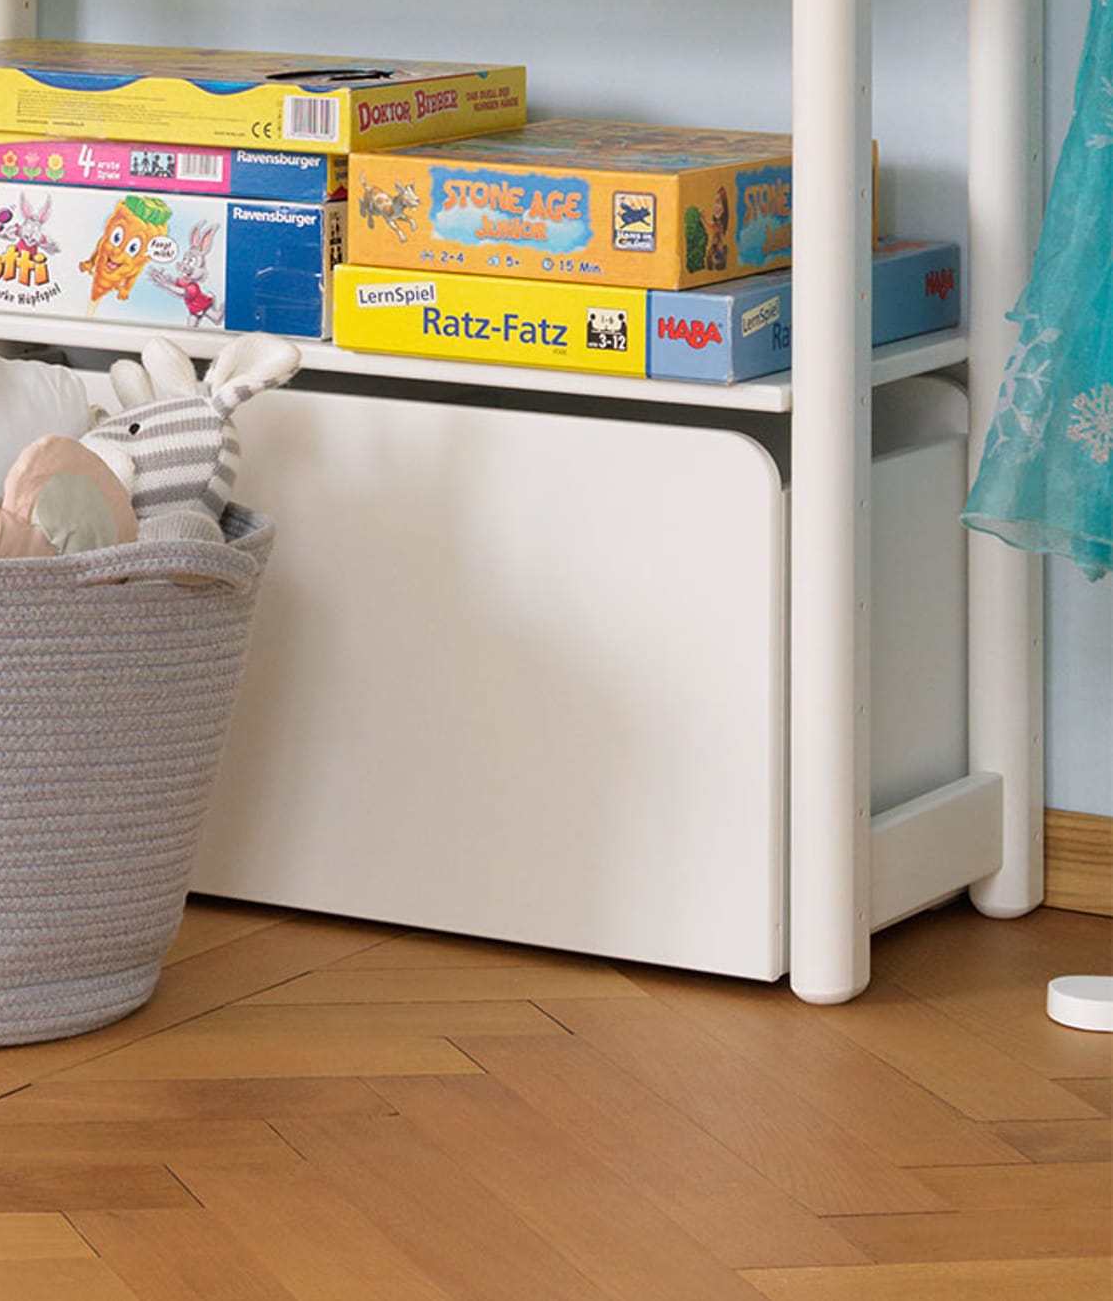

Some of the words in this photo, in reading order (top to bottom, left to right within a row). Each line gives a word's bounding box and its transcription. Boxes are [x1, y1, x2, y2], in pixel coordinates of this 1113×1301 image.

[358, 101, 412, 132] DOKTOR
[415, 90, 458, 119] BIBBER
[77, 144, 96, 179] 4
[237, 151, 322, 169] Ravensburger
[442, 180, 525, 214] STONE
[529, 191, 582, 222] AGE
[233, 207, 317, 227] Ravensburger
[475, 216, 548, 241] JUNIOR
[559, 260, 574, 272] 15
[359, 285, 435, 306] LernSpiel
[925, 269, 954, 300] HABA
[423, 307, 568, 347] Ratz-Fatz
[743, 297, 780, 332] LernSpiel
[598, 333, 626, 350] 3-12
[658, 316, 722, 349] HABA
